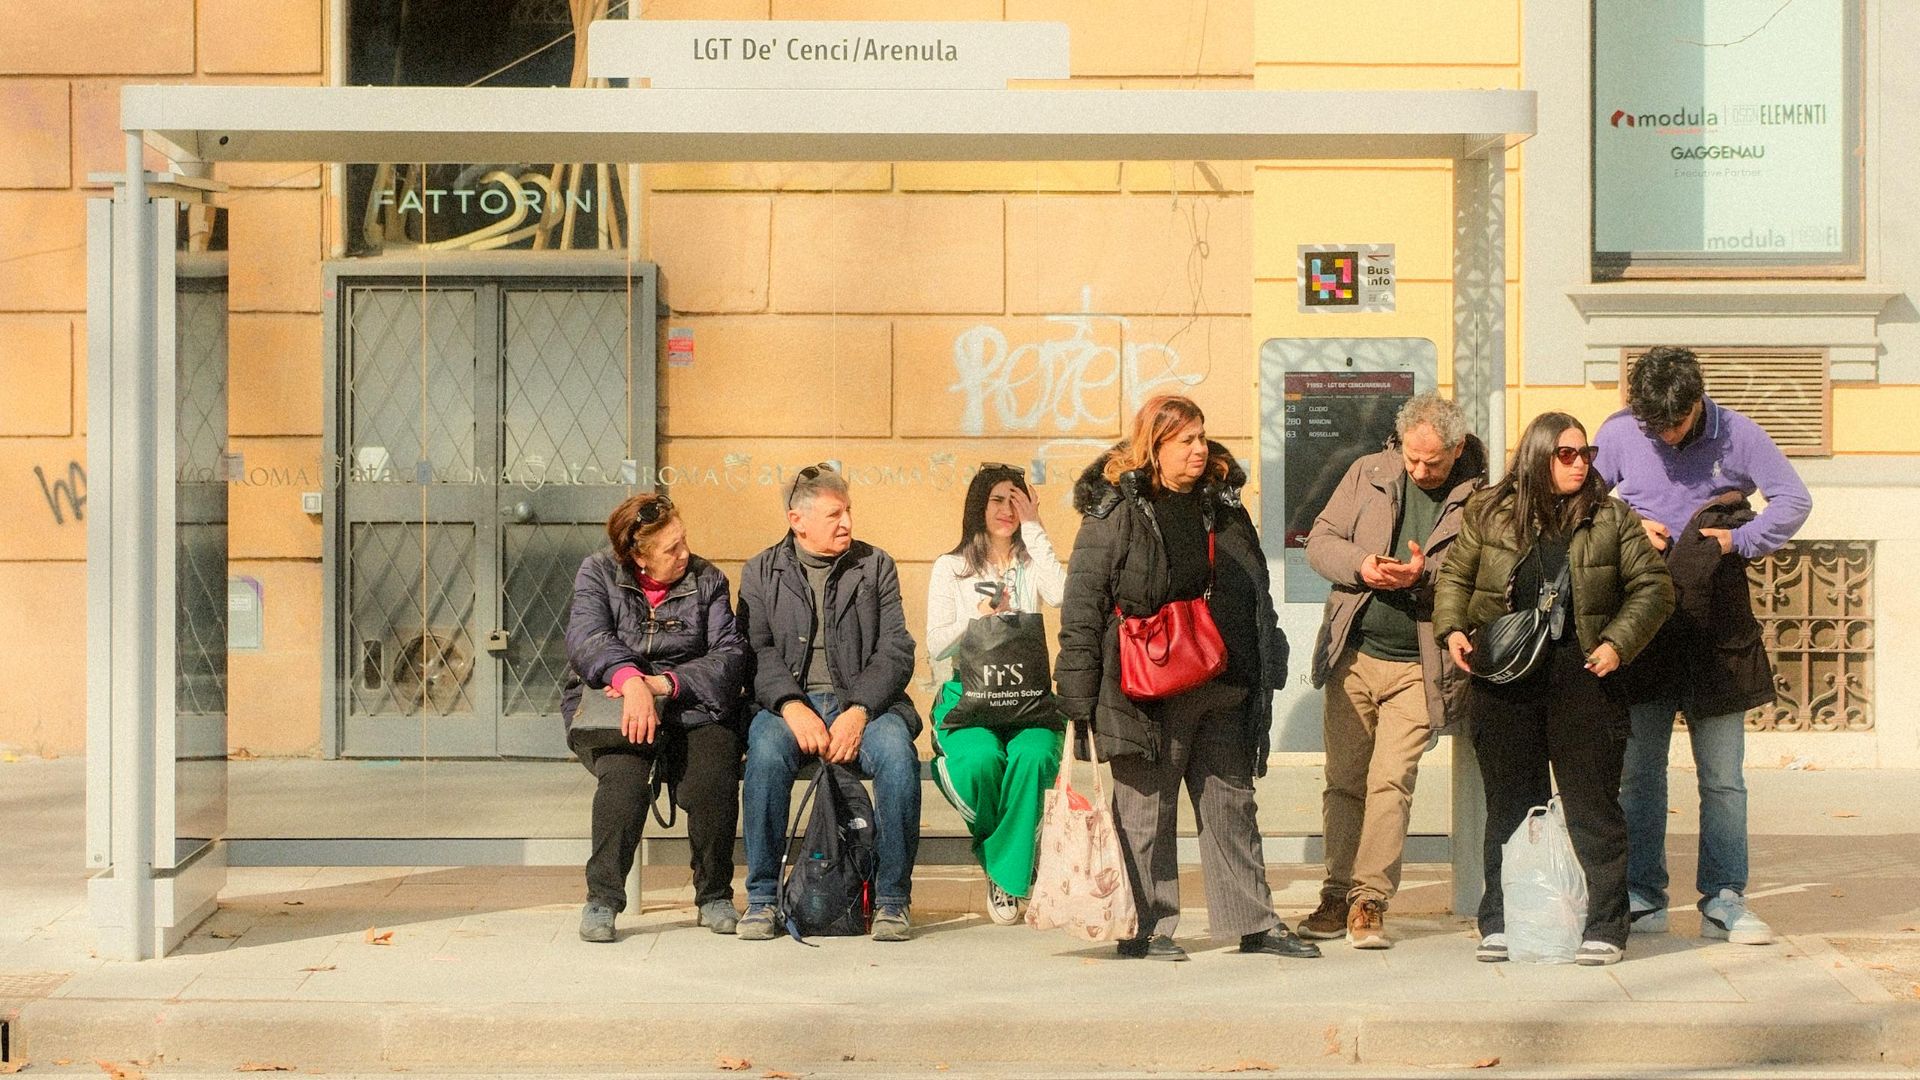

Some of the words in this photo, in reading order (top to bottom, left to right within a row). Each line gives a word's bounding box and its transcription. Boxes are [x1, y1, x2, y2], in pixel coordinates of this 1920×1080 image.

[693, 38, 733, 61] LGT
[742, 38, 777, 61] De'
[786, 37, 959, 62] Cenci/Arenula
[1638, 107, 1718, 127] modula
[1760, 104, 1827, 125] ELEMENTI
[1670, 145, 1766, 160] GAGGENAU
[1725, 168, 1761, 177] Partner
[1707, 228, 1785, 249] modula
[1367, 265, 1390, 275] Bus
[1367, 276, 1390, 286] info
[988, 689, 1020, 699] Fashion
